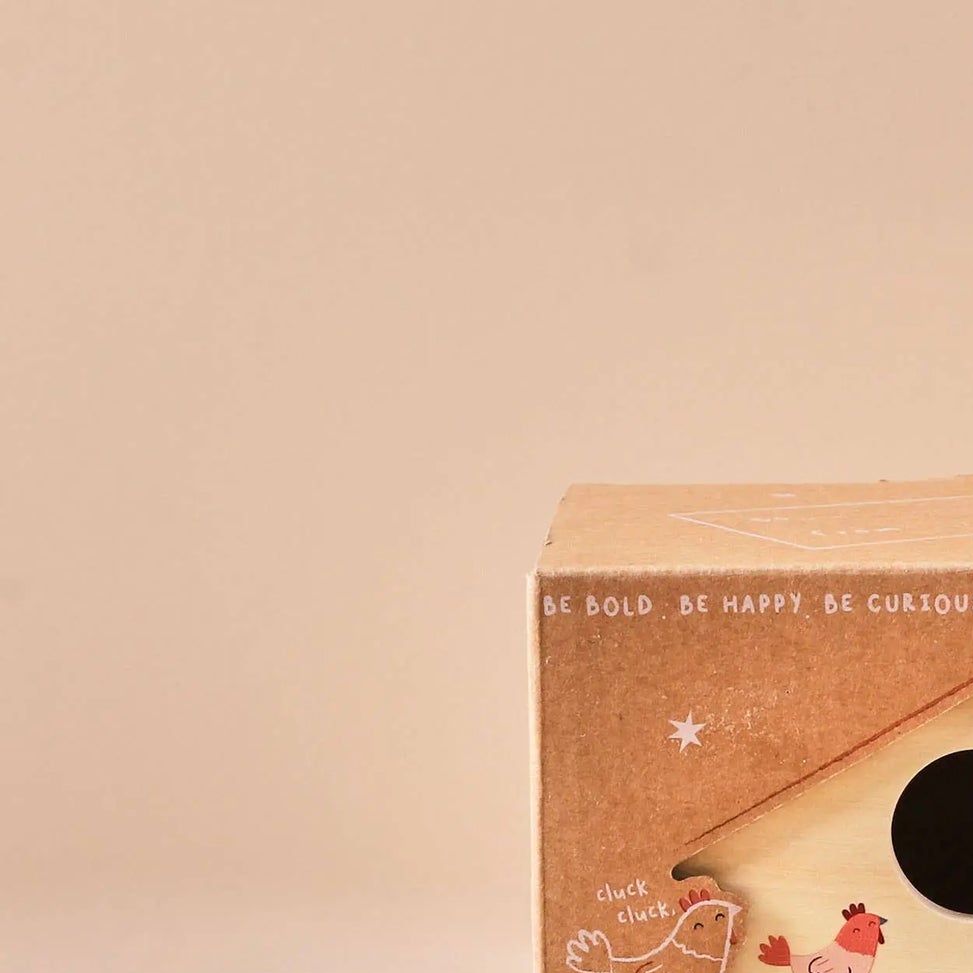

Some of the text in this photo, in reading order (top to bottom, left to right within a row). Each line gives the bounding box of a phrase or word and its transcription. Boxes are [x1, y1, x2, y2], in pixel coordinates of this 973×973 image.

[543, 594, 572, 617] BE
[679, 594, 709, 616] BE
[824, 592, 853, 615] BE
[596, 878, 649, 902] cluck
